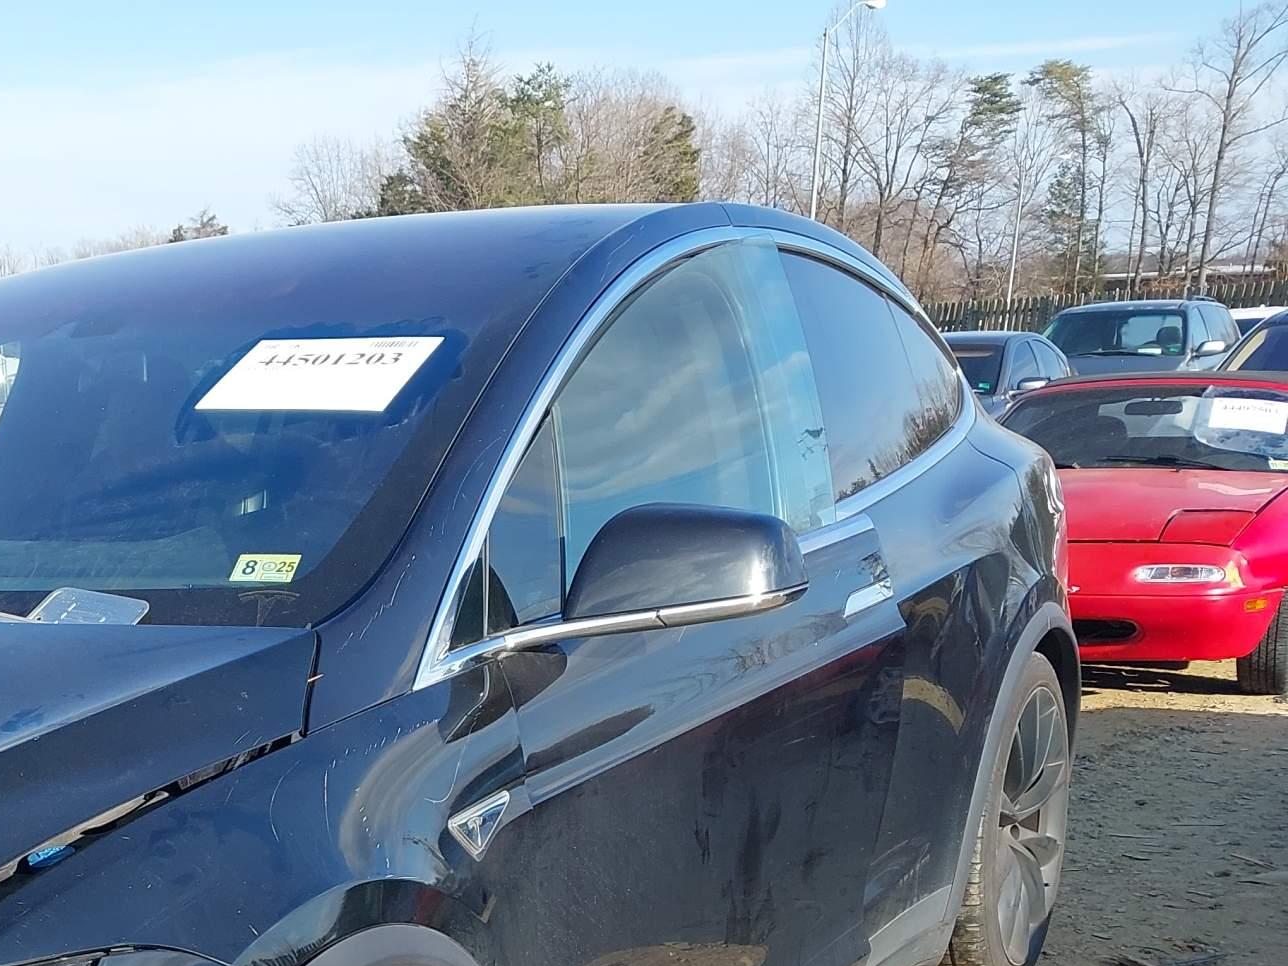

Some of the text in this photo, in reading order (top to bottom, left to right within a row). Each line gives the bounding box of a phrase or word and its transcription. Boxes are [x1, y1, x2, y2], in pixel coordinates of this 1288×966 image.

[258, 352, 404, 367] 44501203
[241, 559, 297, 575] 8 25
